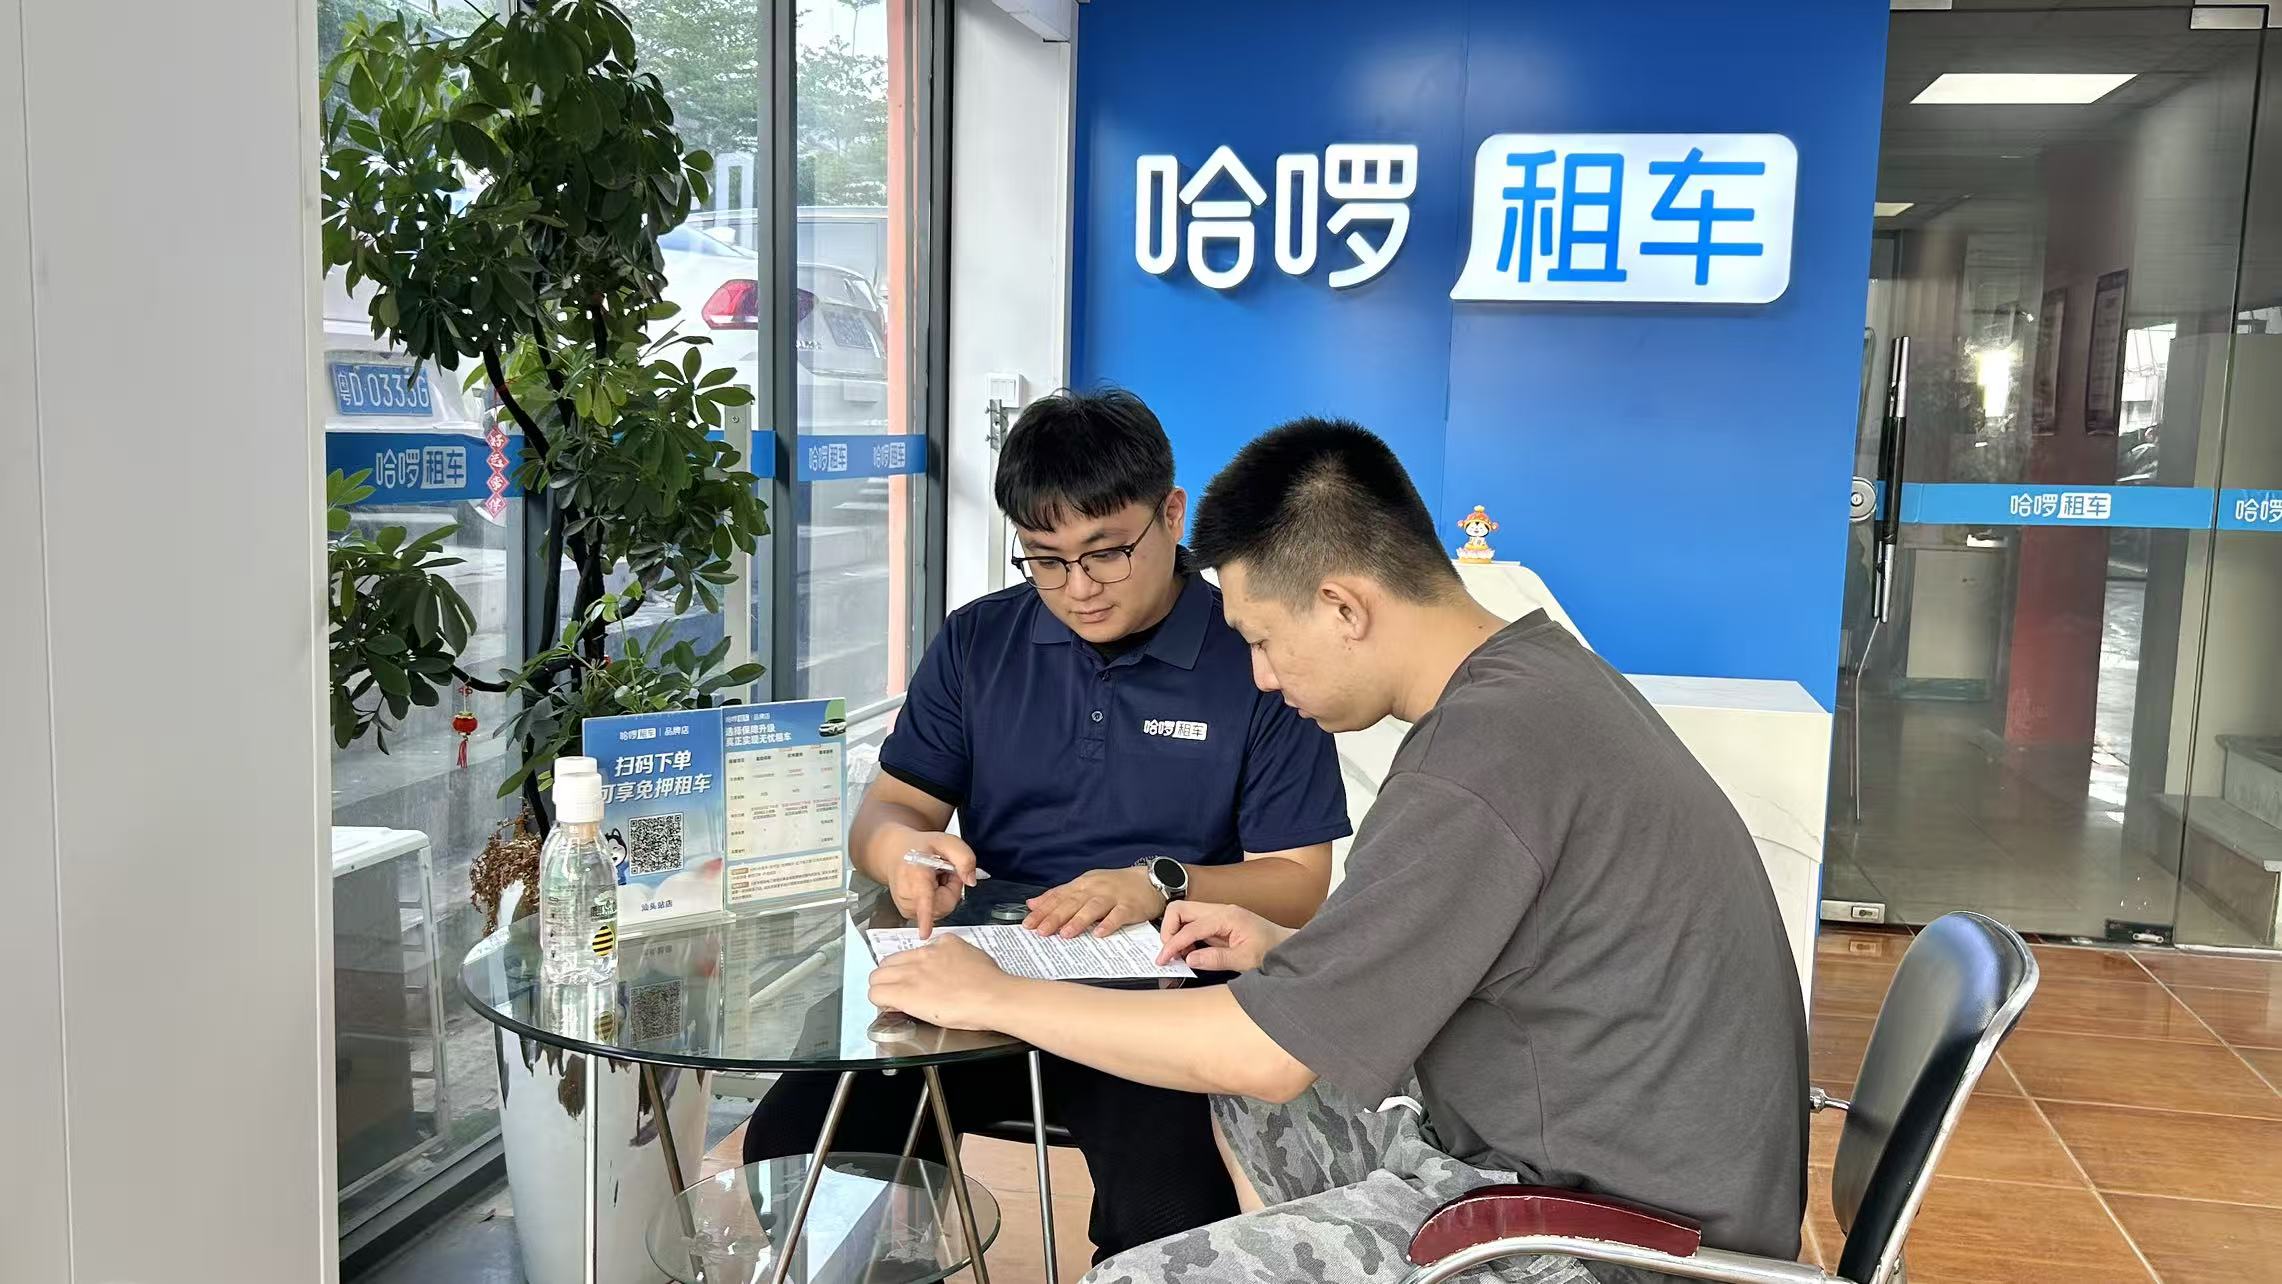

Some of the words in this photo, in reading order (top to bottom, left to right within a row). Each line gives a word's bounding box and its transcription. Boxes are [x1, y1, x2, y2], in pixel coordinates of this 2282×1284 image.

[1135, 144, 1767, 290] 哈啰租车
[376, 448, 466, 488] 哈啰租车
[2010, 493, 2111, 518] 哈啰租车
[664, 726, 689, 736] 品牌店
[1143, 719, 1208, 740] 哈啰租车
[614, 750, 692, 777] 扫码下单
[601, 773, 712, 803] 可享免押租车
